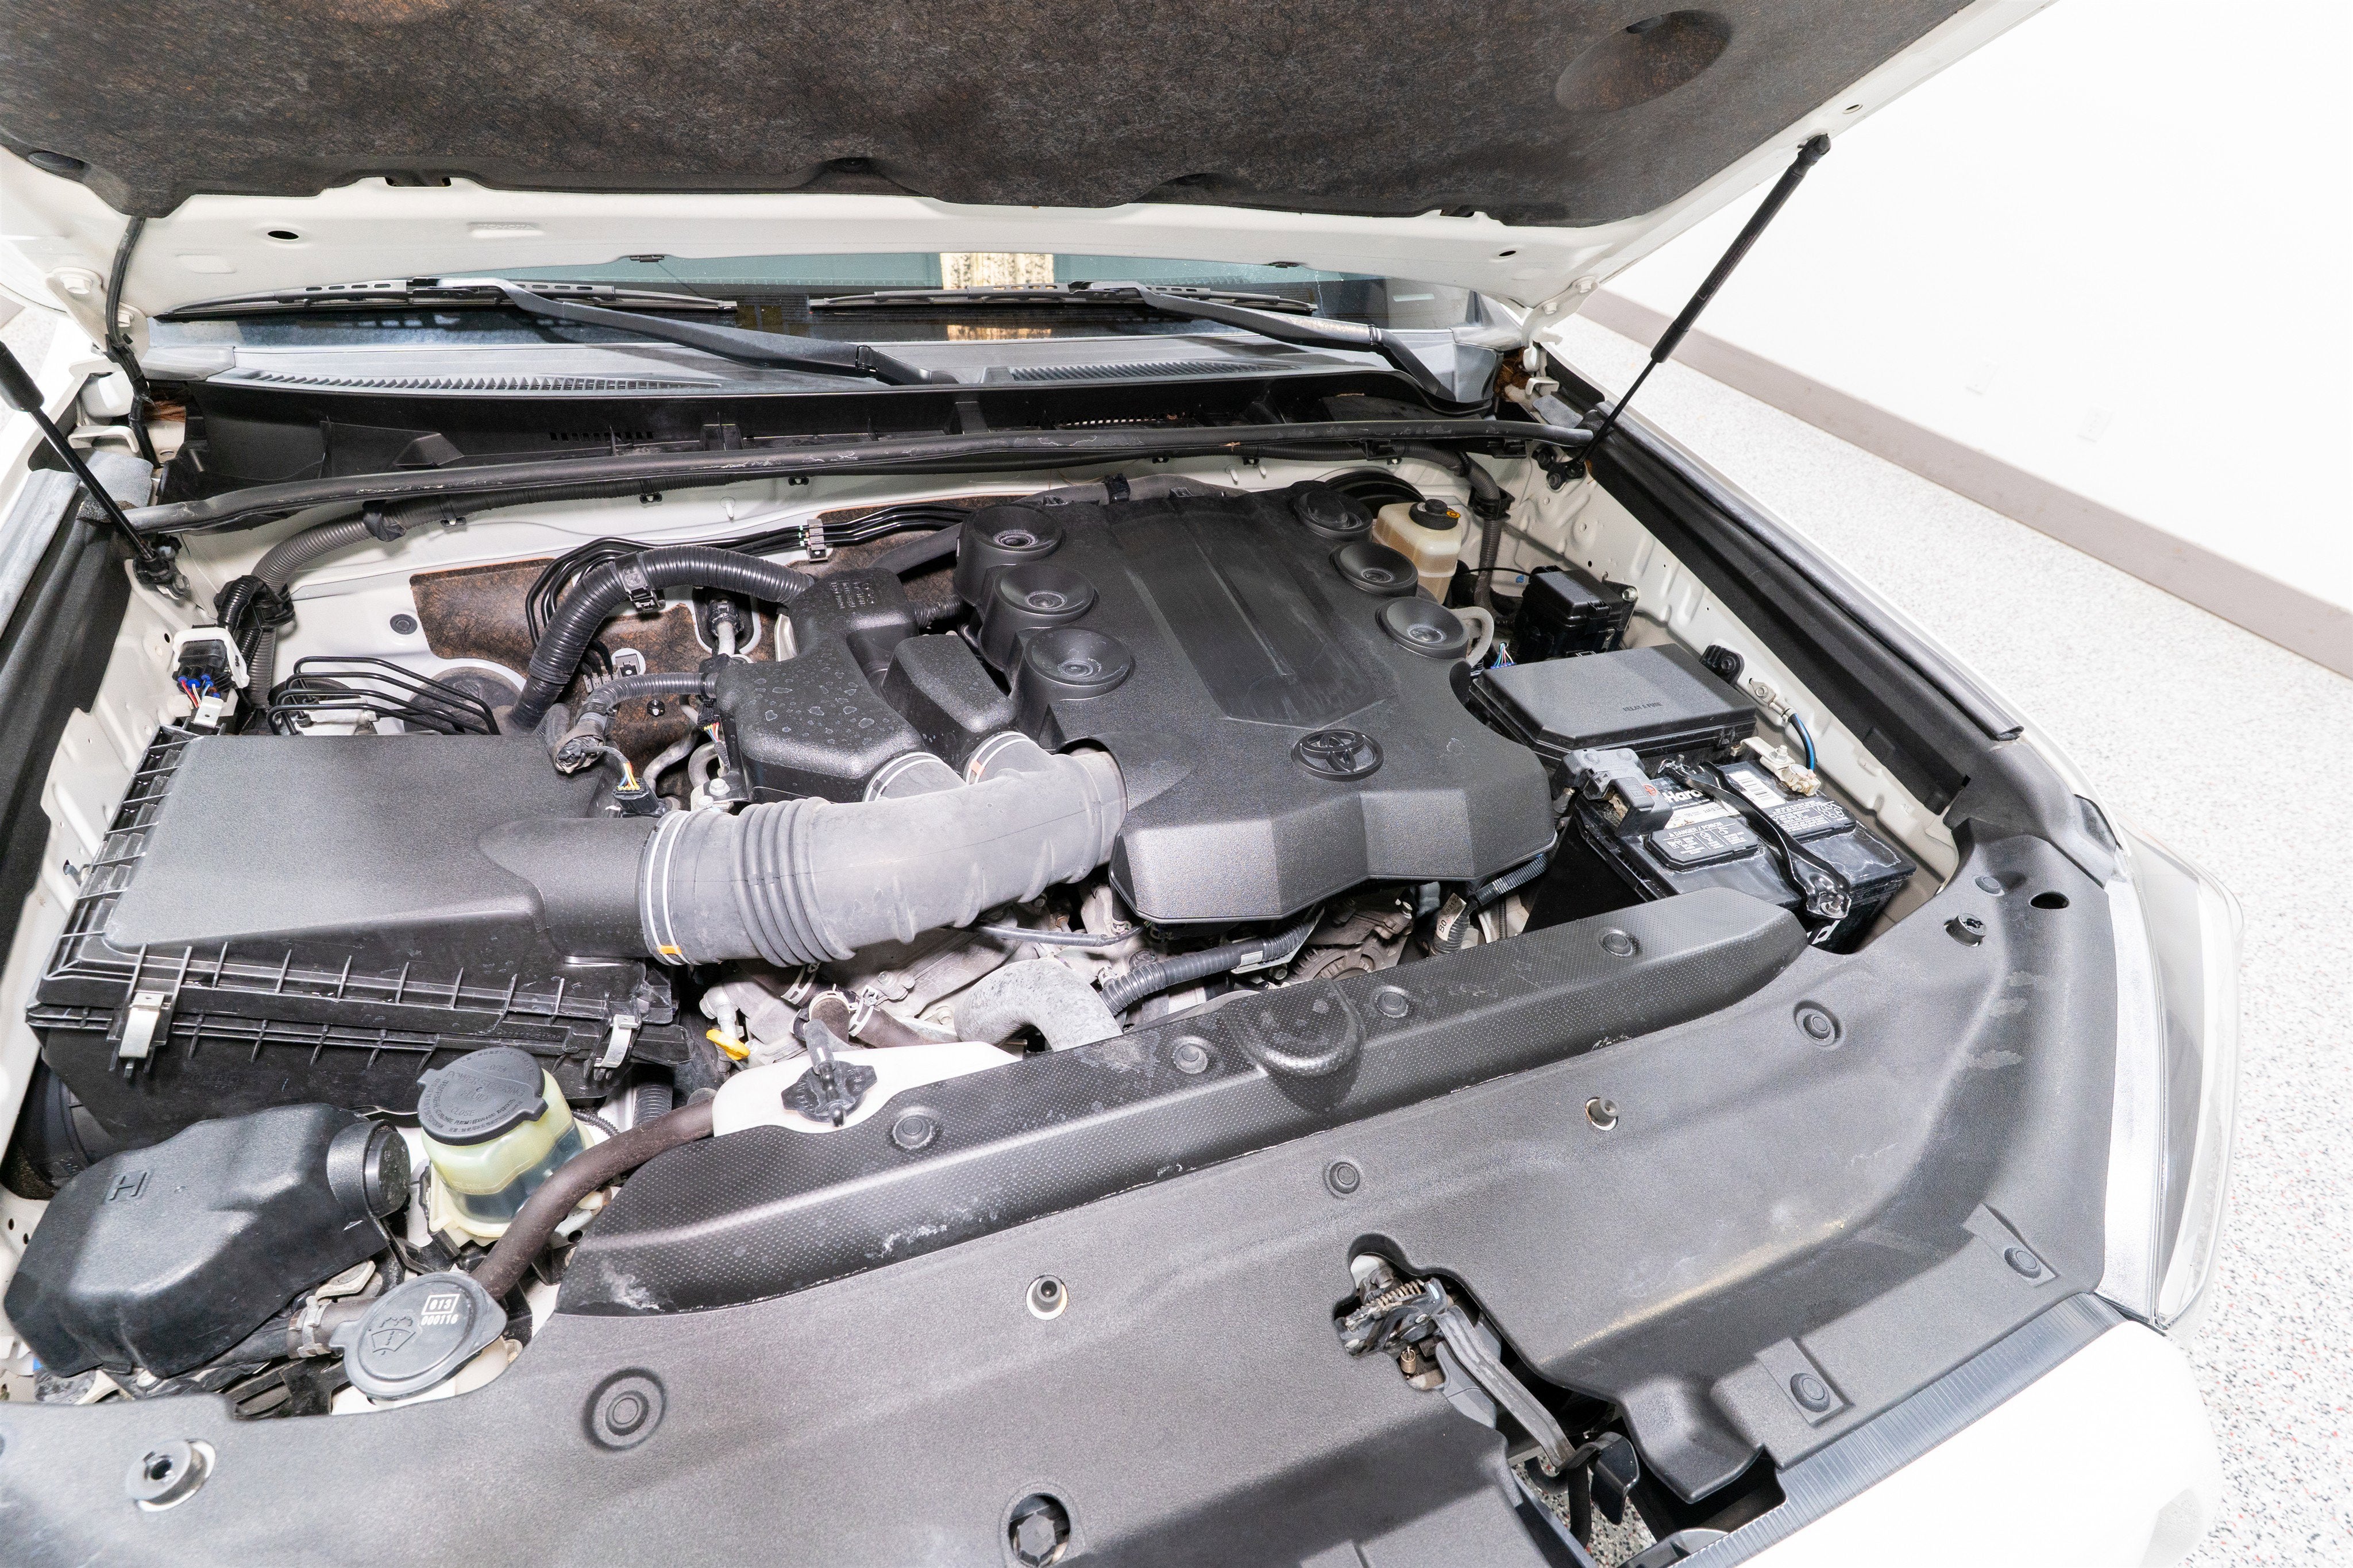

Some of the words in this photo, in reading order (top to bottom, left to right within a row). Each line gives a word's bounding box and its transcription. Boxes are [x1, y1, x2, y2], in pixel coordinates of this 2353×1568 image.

[1661, 789, 1703, 803] Hard
[1675, 827, 1699, 836] DANGER
[1701, 821, 1724, 831] POISON
[489, 1064, 507, 1073] OPEN
[445, 1071, 480, 1086] POWER
[480, 1078, 525, 1098] STEERING
[451, 1105, 476, 1117] CLOSE
[421, 1314, 459, 1326] 000116
